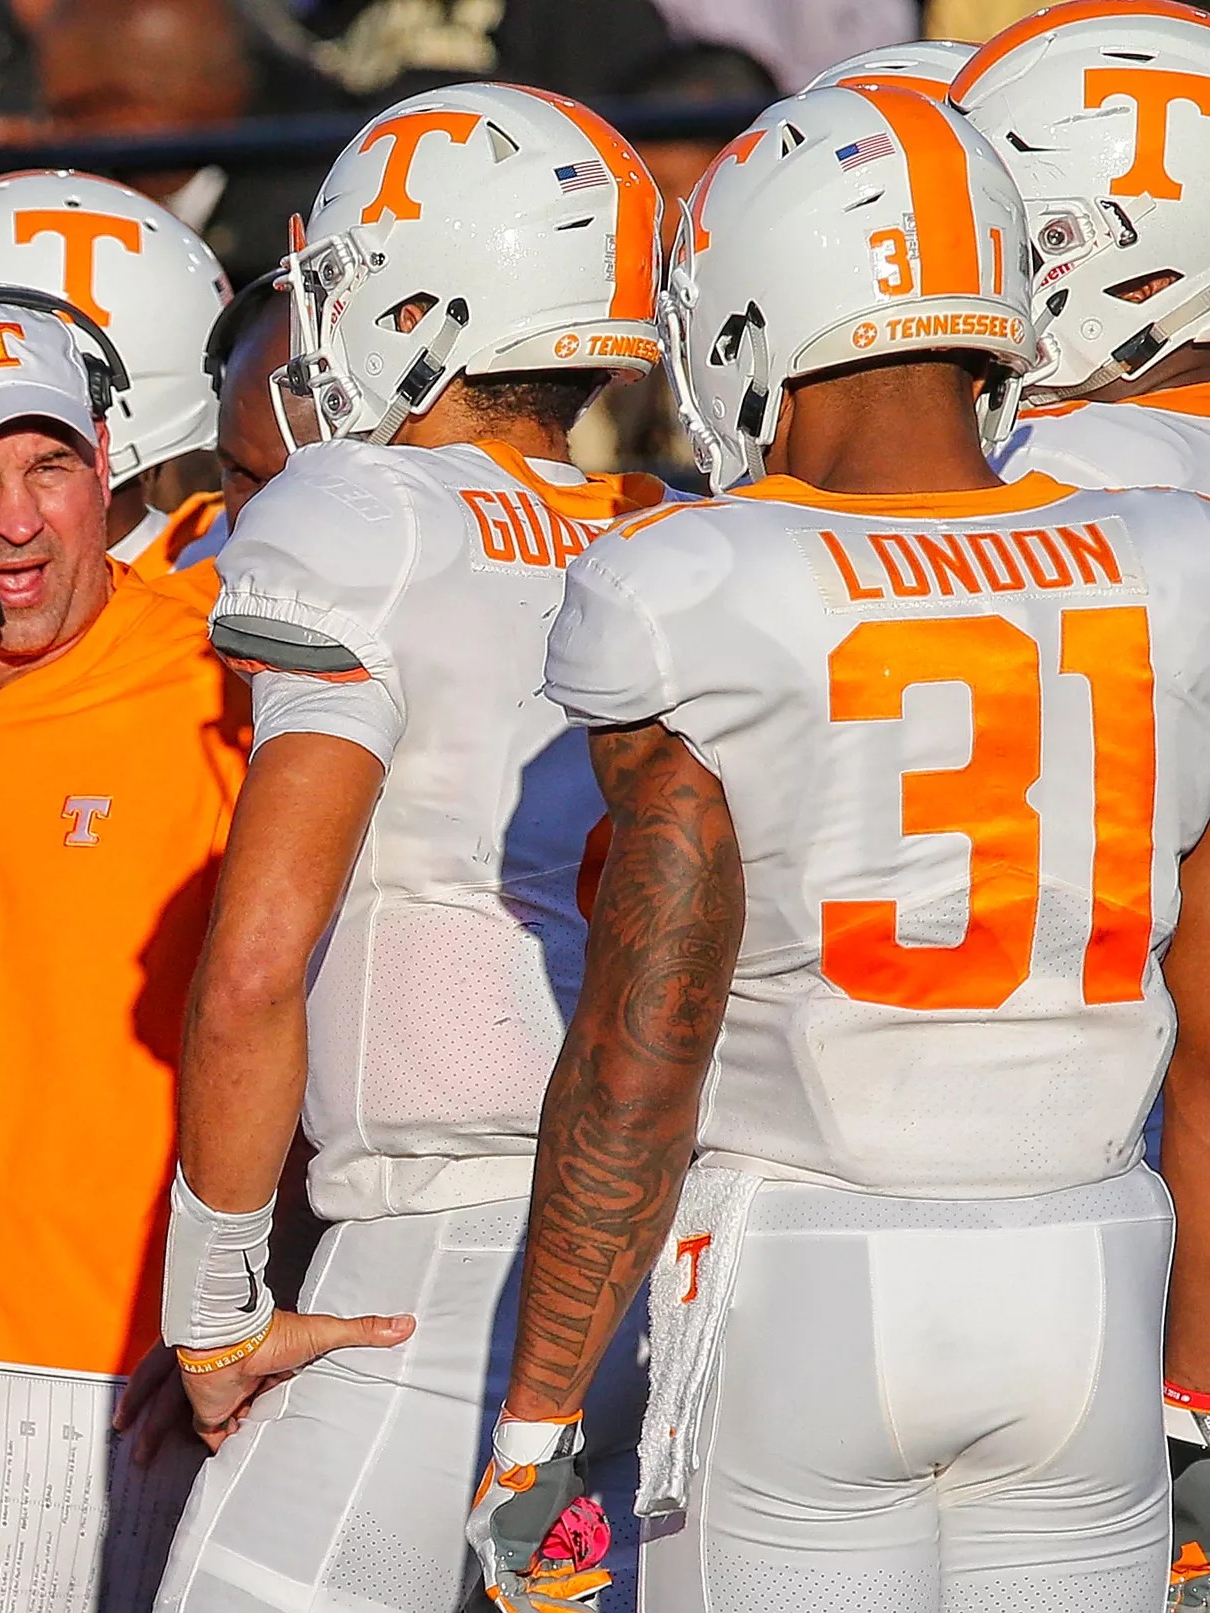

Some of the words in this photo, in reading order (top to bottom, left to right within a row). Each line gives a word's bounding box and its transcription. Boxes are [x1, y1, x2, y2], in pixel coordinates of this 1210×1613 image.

[358, 110, 484, 225] T
[1083, 67, 1210, 201] T
[13, 209, 143, 328] T
[869, 227, 914, 297] 3
[886, 313, 1009, 342] TENNESSEE
[819, 521, 1124, 601] LONDON
[61, 795, 114, 847] T
[820, 605, 1157, 1010] 31
[215, 1349, 245, 1368] OVER
